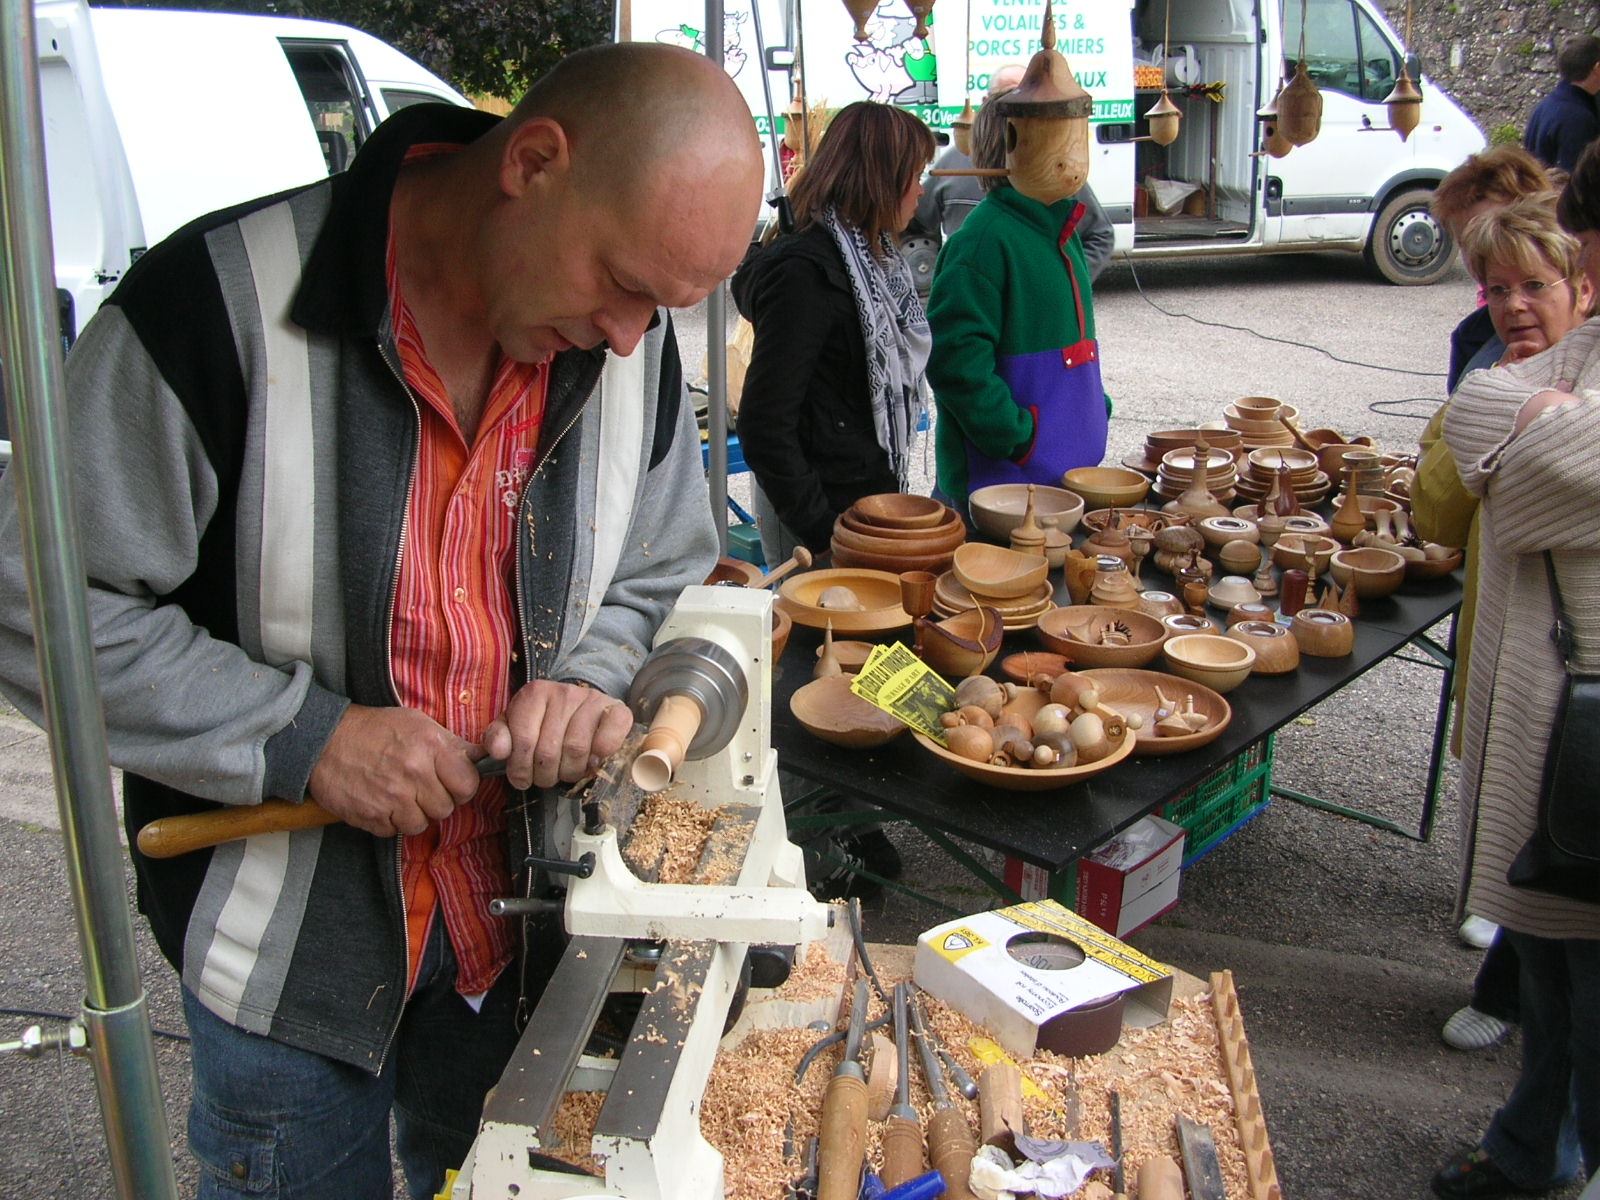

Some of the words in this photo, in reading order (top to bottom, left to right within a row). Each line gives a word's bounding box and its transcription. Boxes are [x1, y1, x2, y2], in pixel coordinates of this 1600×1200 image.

[982, 14, 1066, 30] VOLAILS
[1073, 14, 1085, 30] &
[967, 39, 1021, 56] PORCS
[1028, 38, 1104, 55] FEMIERS
[1091, 103, 1133, 118] EILLEUX
